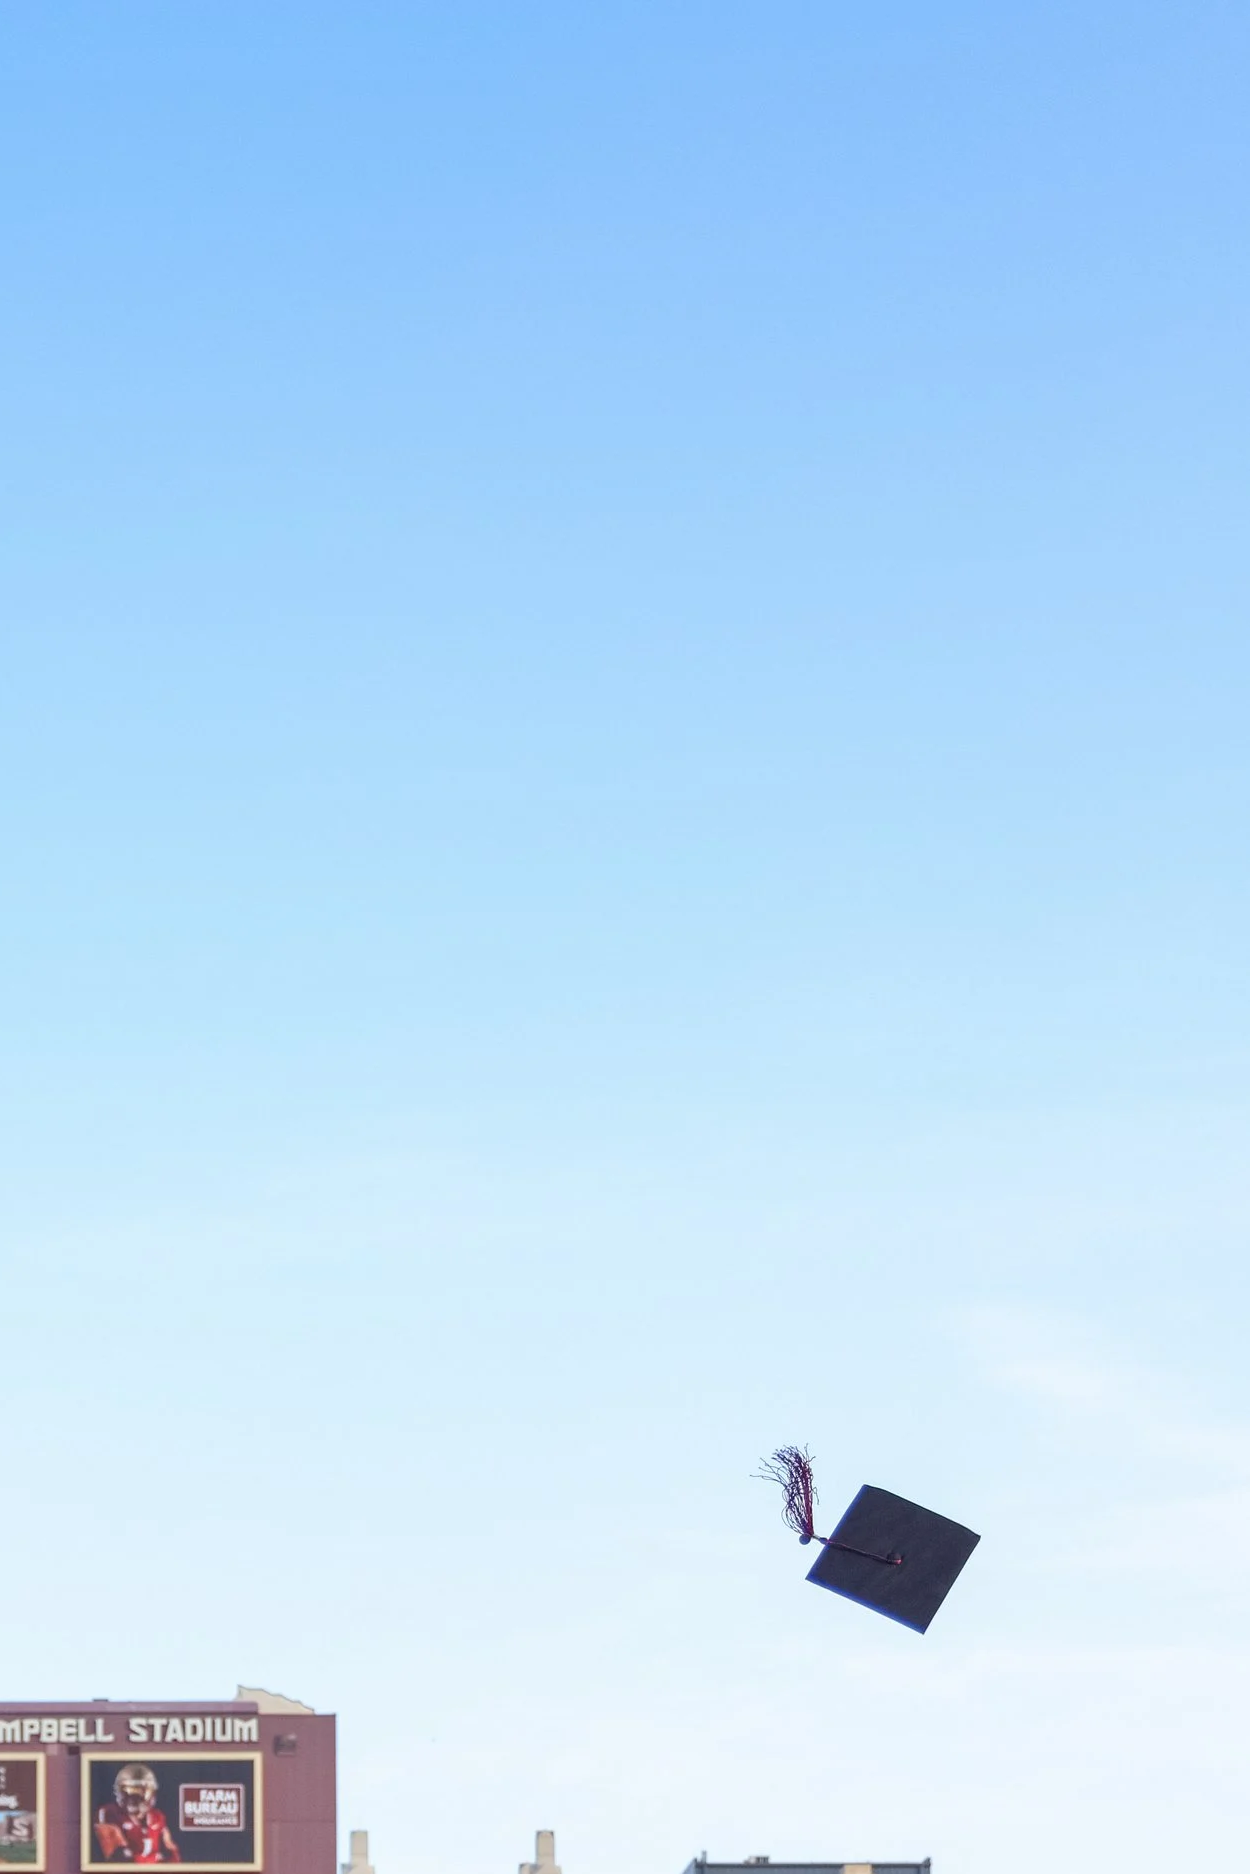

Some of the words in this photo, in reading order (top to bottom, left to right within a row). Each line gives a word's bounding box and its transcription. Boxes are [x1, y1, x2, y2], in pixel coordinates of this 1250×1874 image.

[129, 1717, 259, 1743] STADIUM
[200, 1789, 237, 1802] FARM
[184, 1801, 238, 1815] BUREAU
